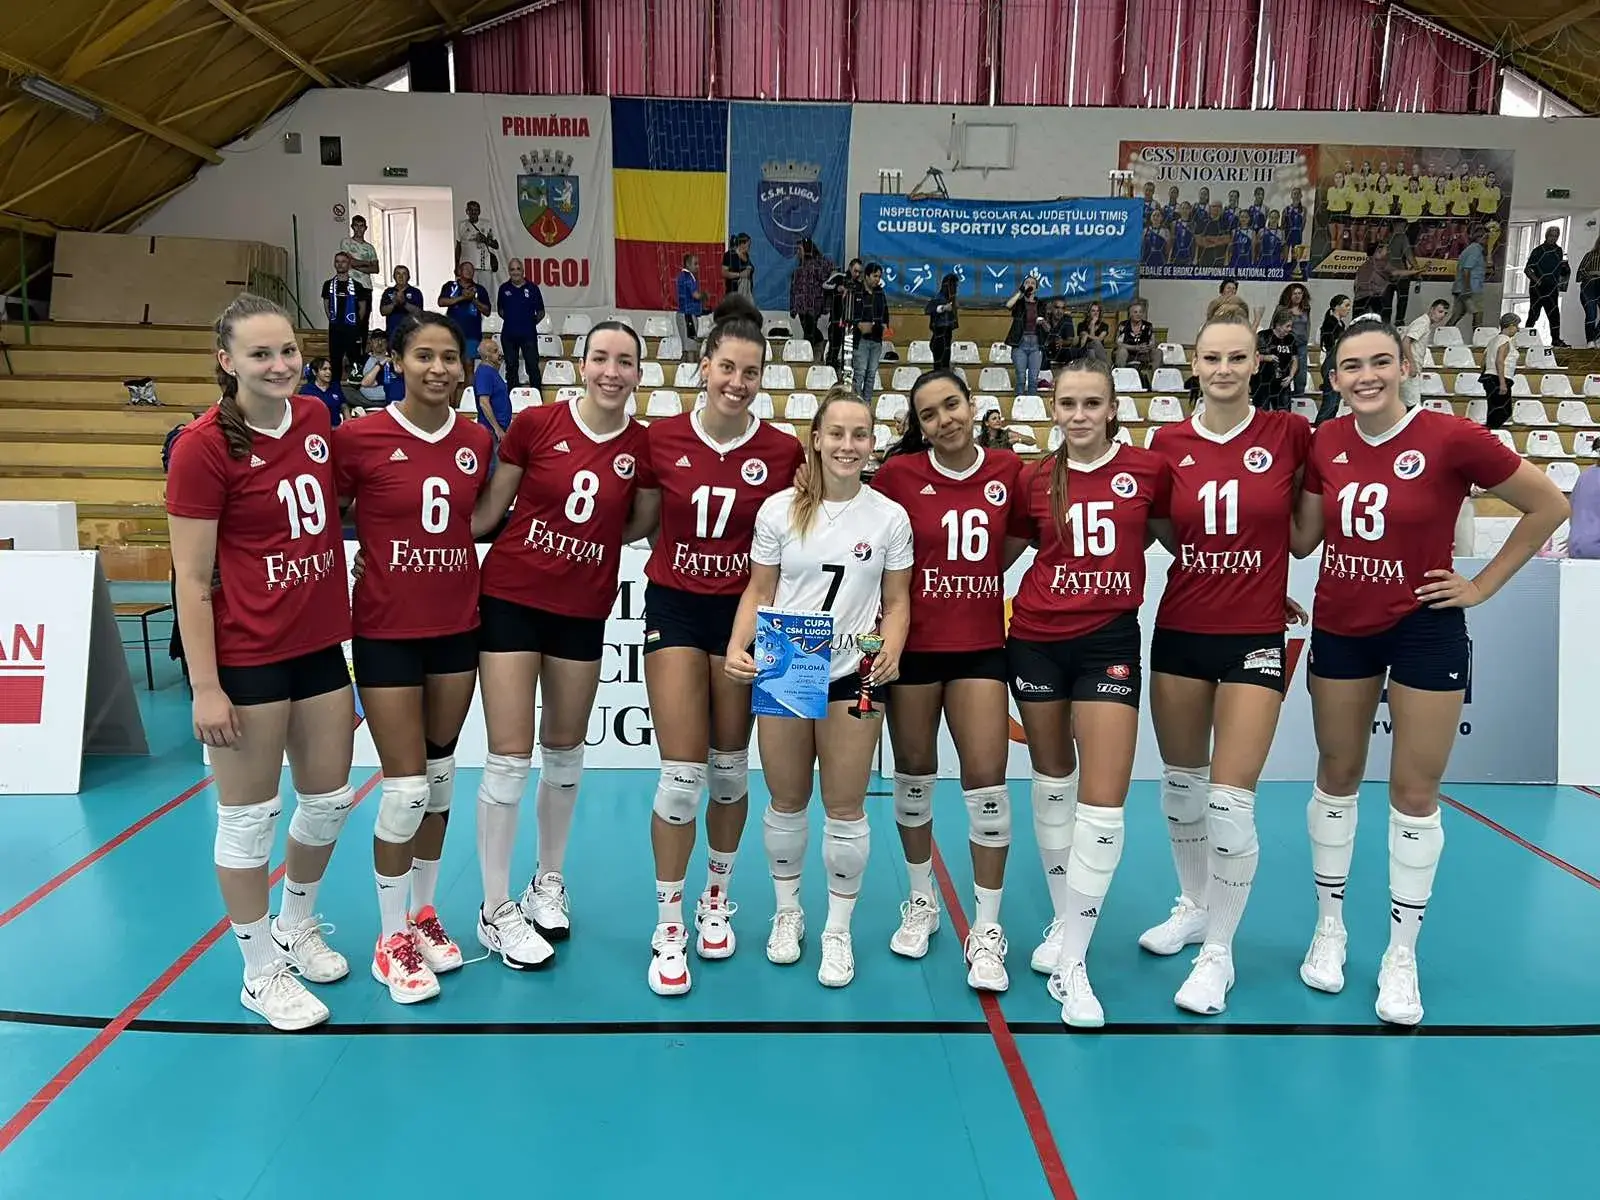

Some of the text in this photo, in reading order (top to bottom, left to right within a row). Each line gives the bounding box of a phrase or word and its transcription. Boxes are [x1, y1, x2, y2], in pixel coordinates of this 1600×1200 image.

[502, 113, 590, 137] PRIMĂRIA
[1142, 147, 1175, 163] CSS
[1180, 147, 1239, 164] LUGOJ
[1157, 166, 1275, 183] JUNIOARE III
[789, 186, 820, 203] LUGOJ
[879, 207, 969, 219] INSPECTORATUL
[1019, 211, 1034, 220] AL
[877, 220, 937, 234] CLUBUL
[941, 222, 1006, 235] SPORTIV
[1075, 224, 1126, 237] LUGOJ
[523, 258, 590, 288] UGOJ
[1140, 266, 1162, 276] EDALIE
[1164, 267, 1172, 276] DE
[1194, 267, 1235, 277] CAMPIONATUL
[1267, 268, 1284, 278] 2023
[277, 473, 327, 540] 19
[421, 476, 450, 534] 6
[565, 469, 600, 524] 8
[1197, 479, 1239, 535] 11
[691, 485, 737, 538] 17
[1337, 482, 1389, 541] 13
[526, 518, 605, 561] FATUM
[941, 508, 989, 562] 16
[1065, 501, 1116, 557] 15
[389, 538, 468, 567] FATUM
[821, 563, 845, 611] 7
[922, 566, 999, 594] FATUM
[1050, 563, 1131, 589] FATUM
[1050, 587, 1132, 596] PROPERTY
[785, 627, 831, 636] CSM LUGOJ
[804, 619, 831, 628] CUPA
[1097, 682, 1130, 695] TICO
